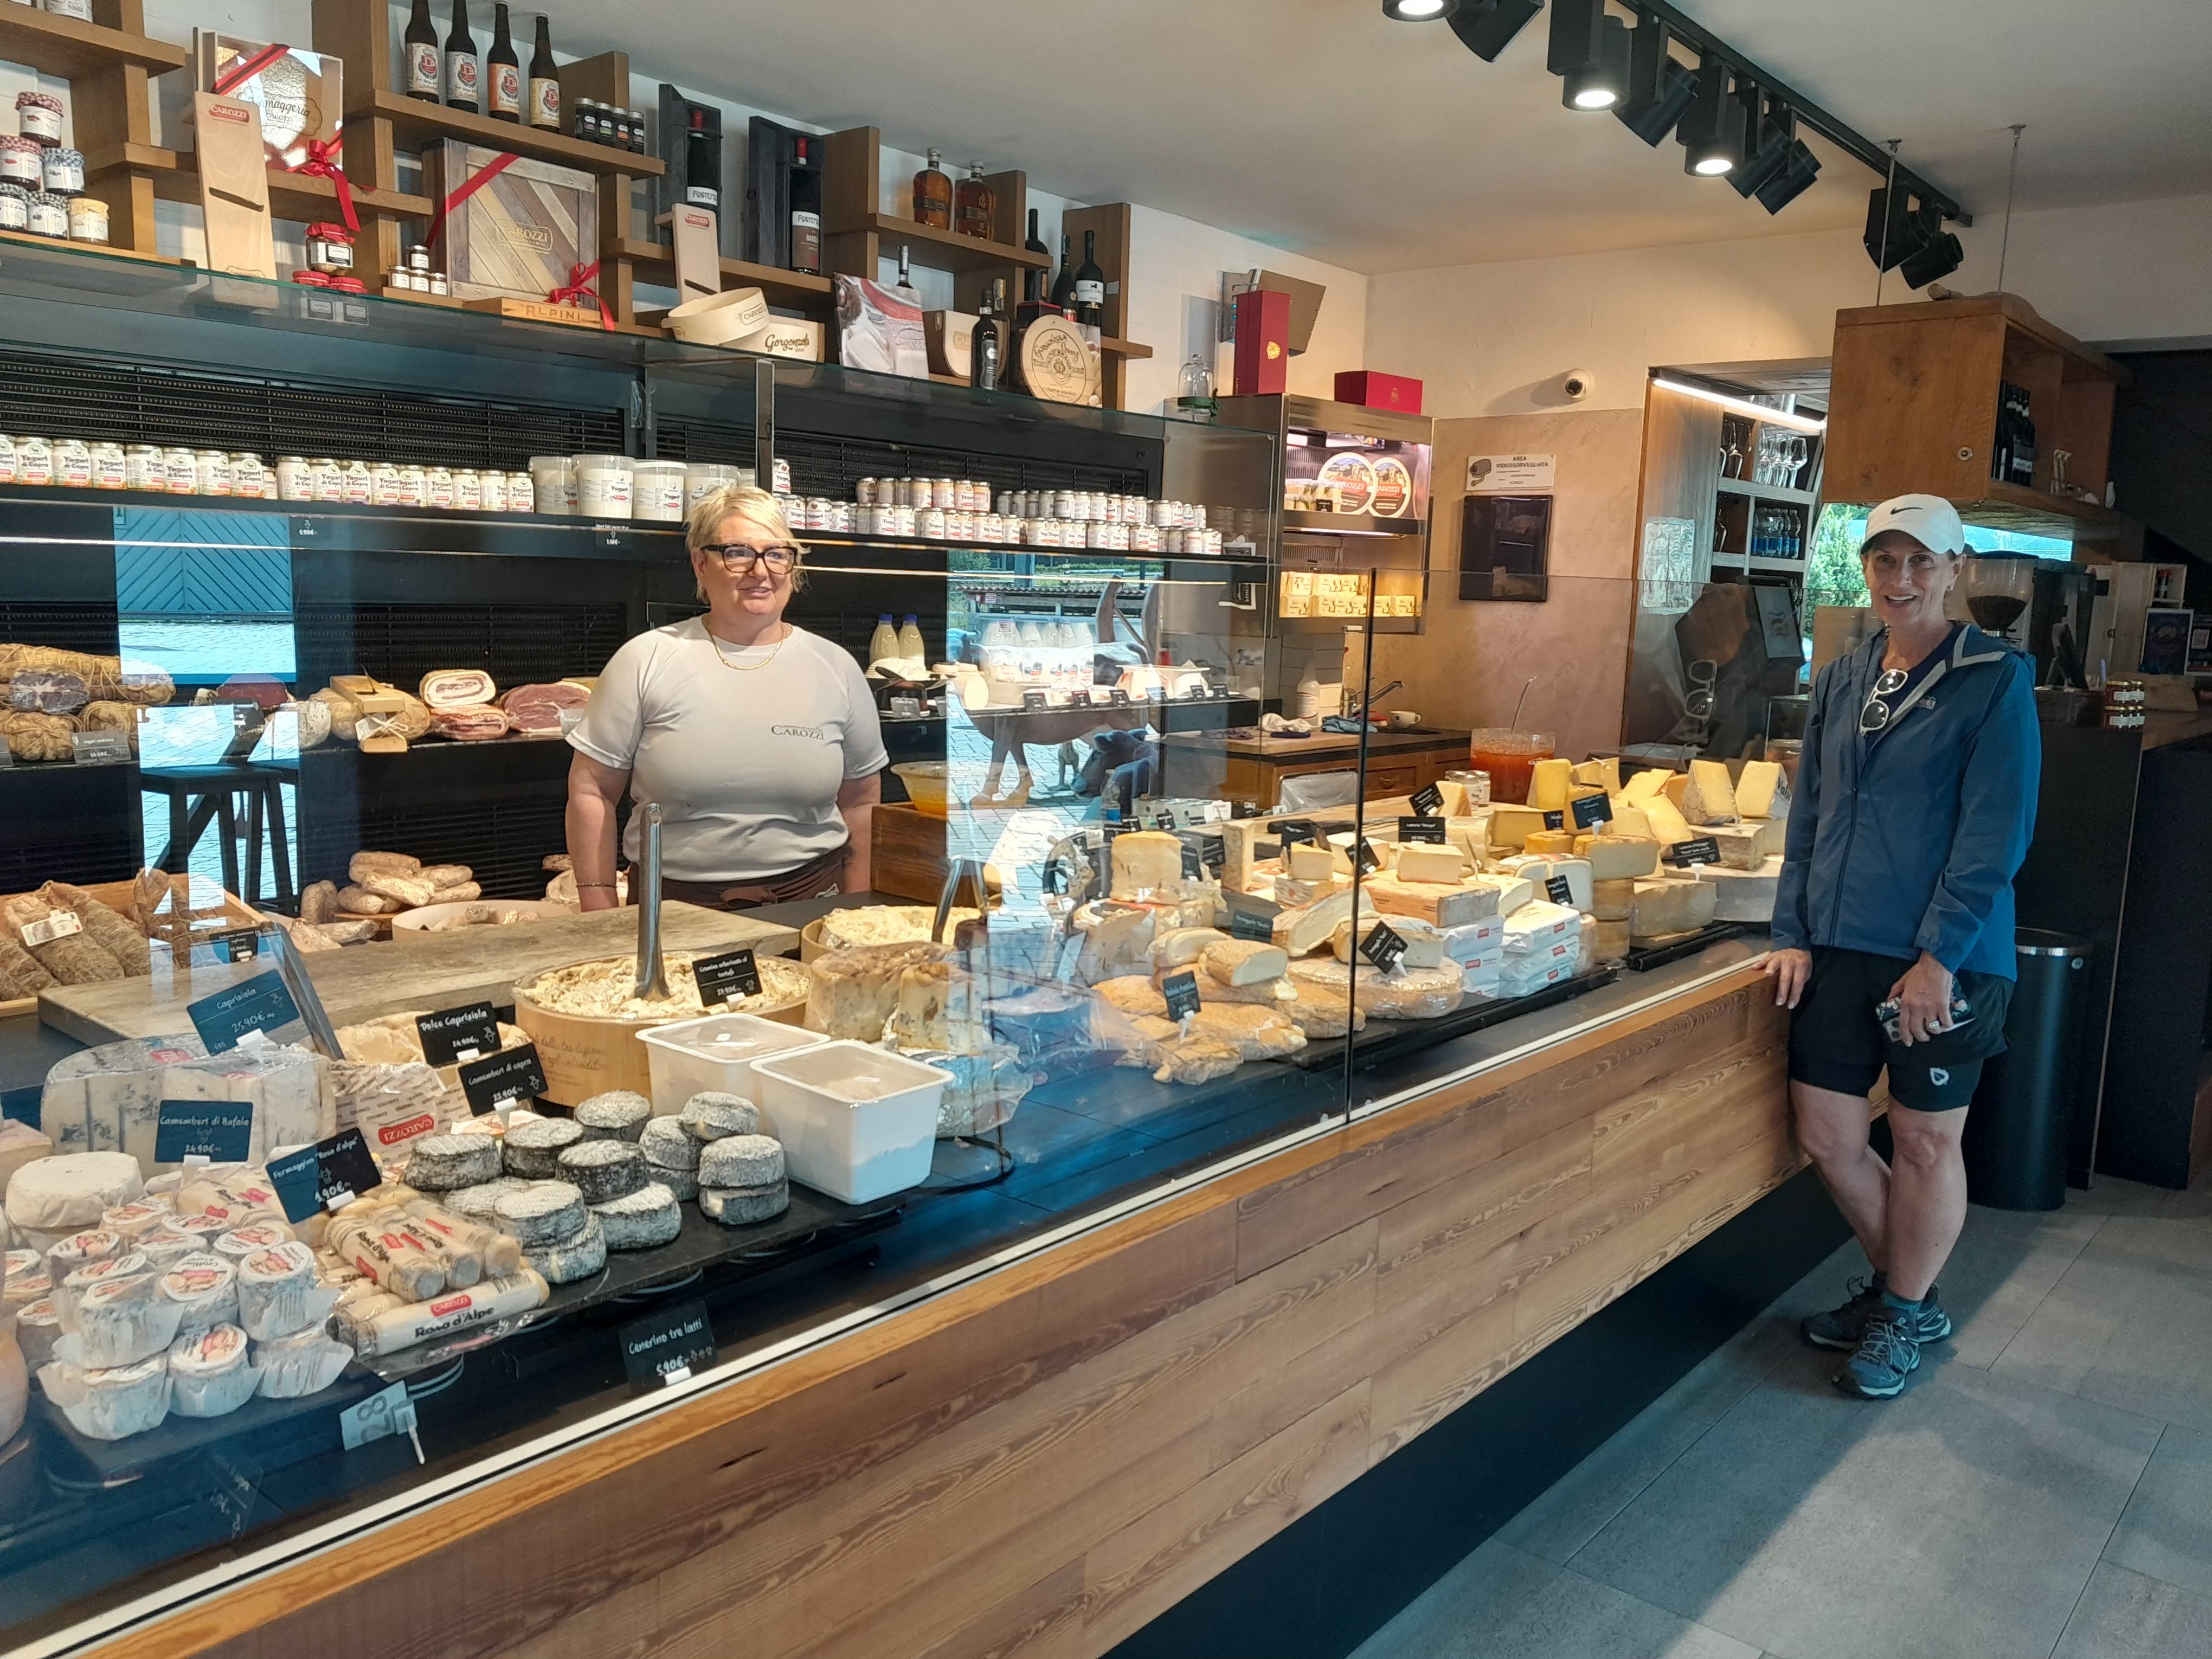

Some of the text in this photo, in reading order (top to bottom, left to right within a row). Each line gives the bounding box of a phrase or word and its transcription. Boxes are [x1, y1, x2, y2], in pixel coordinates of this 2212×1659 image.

[210, 105, 247, 119] CAROZZI
[526, 304, 581, 323] ALPINI
[21, 454, 48, 462] Yogurt
[237, 469, 261, 477] Yogurt
[420, 1019, 443, 1031] Dolce
[468, 1066, 505, 1086] Camembert
[506, 1063, 513, 1072] di
[159, 1115, 249, 1128] Camembert di Bufala
[382, 1117, 433, 1142] CAROZZI
[415, 1306, 494, 1338] Rosa d'Alpe
[628, 1315, 703, 1355] Cenerino tre latti
